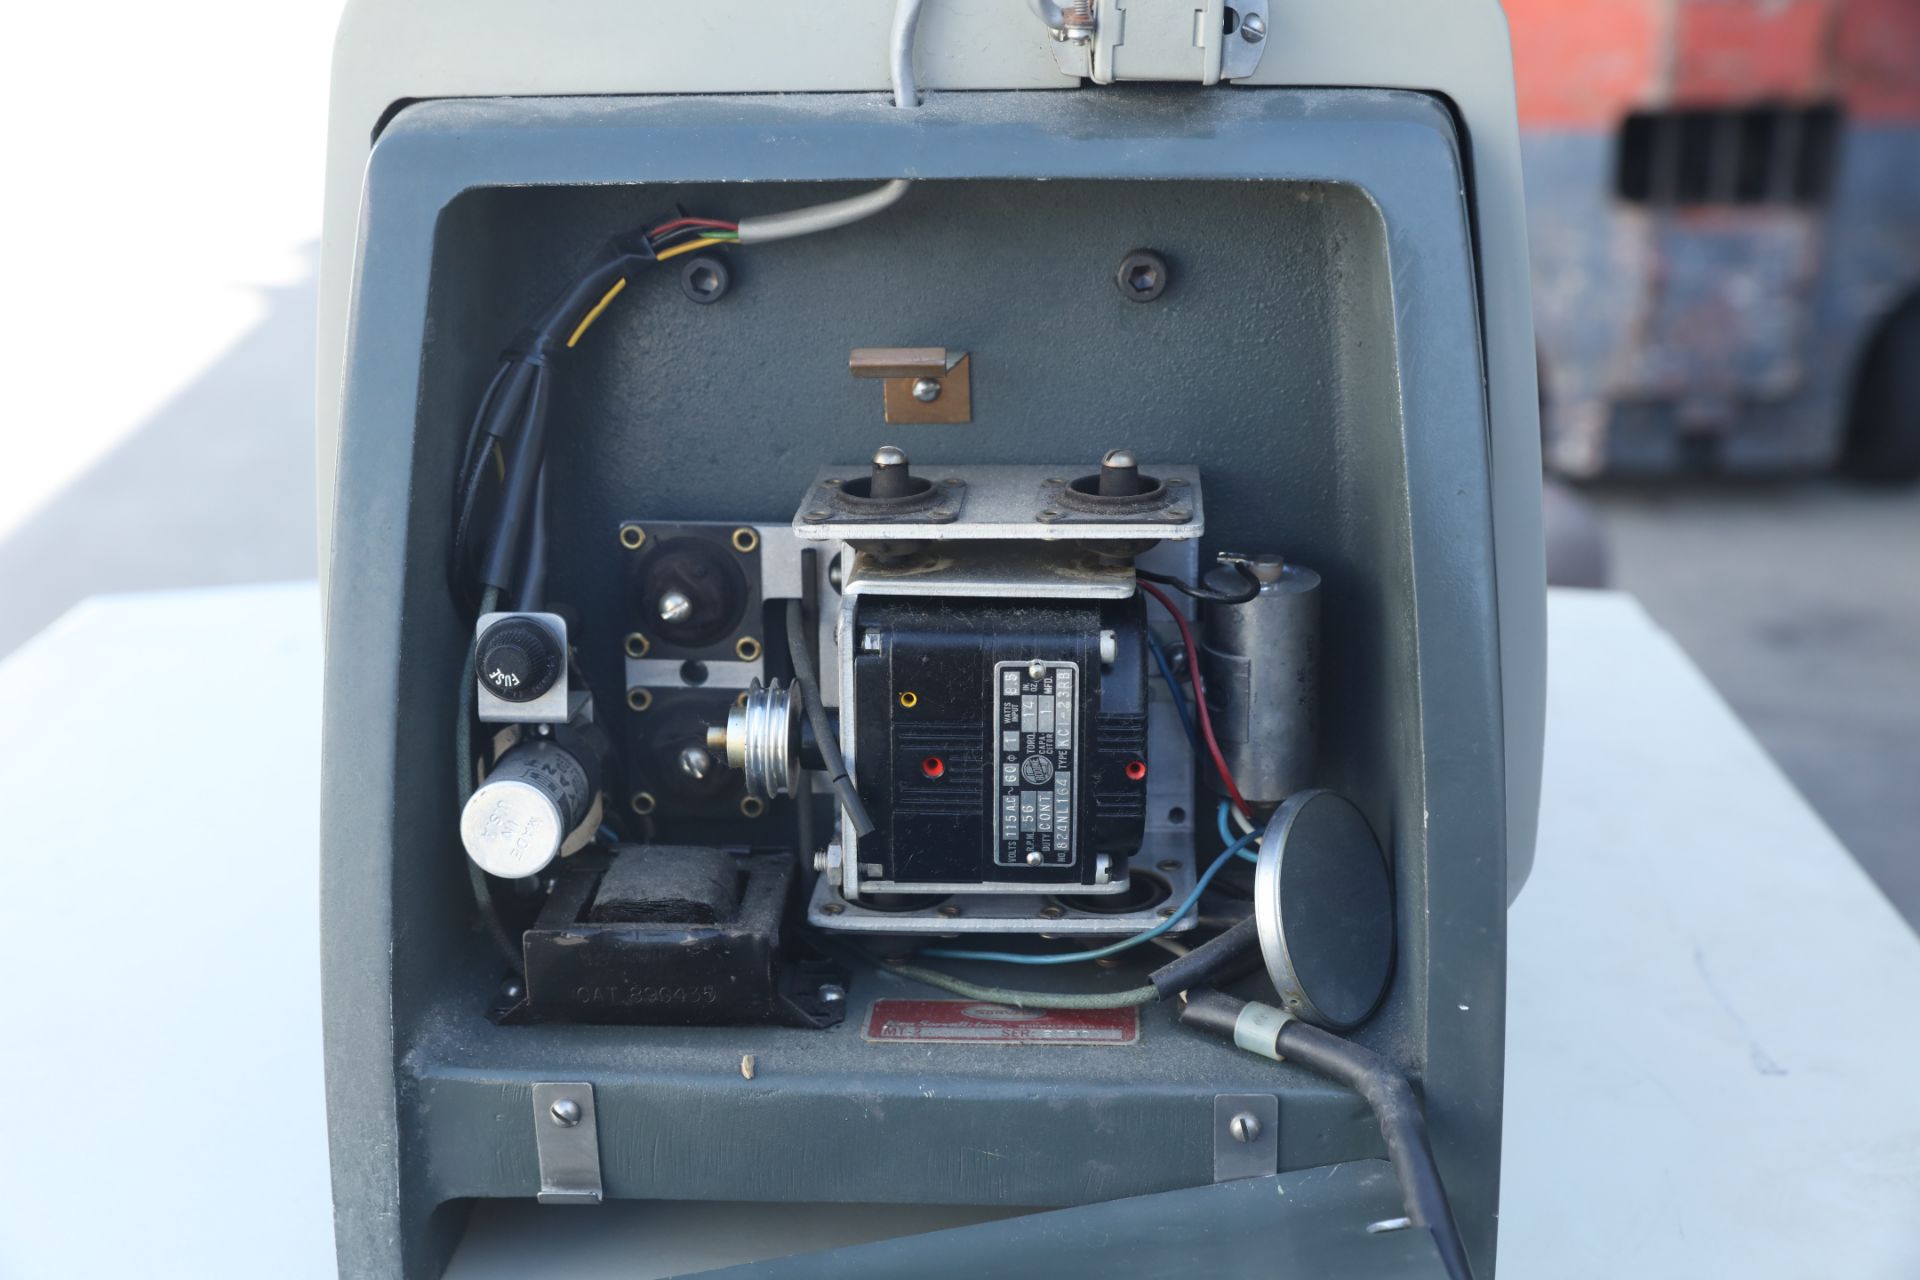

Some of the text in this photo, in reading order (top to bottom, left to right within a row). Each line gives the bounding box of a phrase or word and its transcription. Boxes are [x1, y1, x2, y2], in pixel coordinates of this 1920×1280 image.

[489, 667, 520, 687] FUSE
[1004, 673, 1018, 695] 8.5
[1023, 701, 1035, 717] 14
[1058, 750, 1068, 770] TYPE
[1004, 766, 1017, 783] 60
[1022, 805, 1034, 823] 56
[1056, 778, 1070, 849] 824NL164
[1005, 811, 1017, 837] 115
[1007, 841, 1017, 863] VOLTS
[1042, 834, 1051, 851] DUTY
